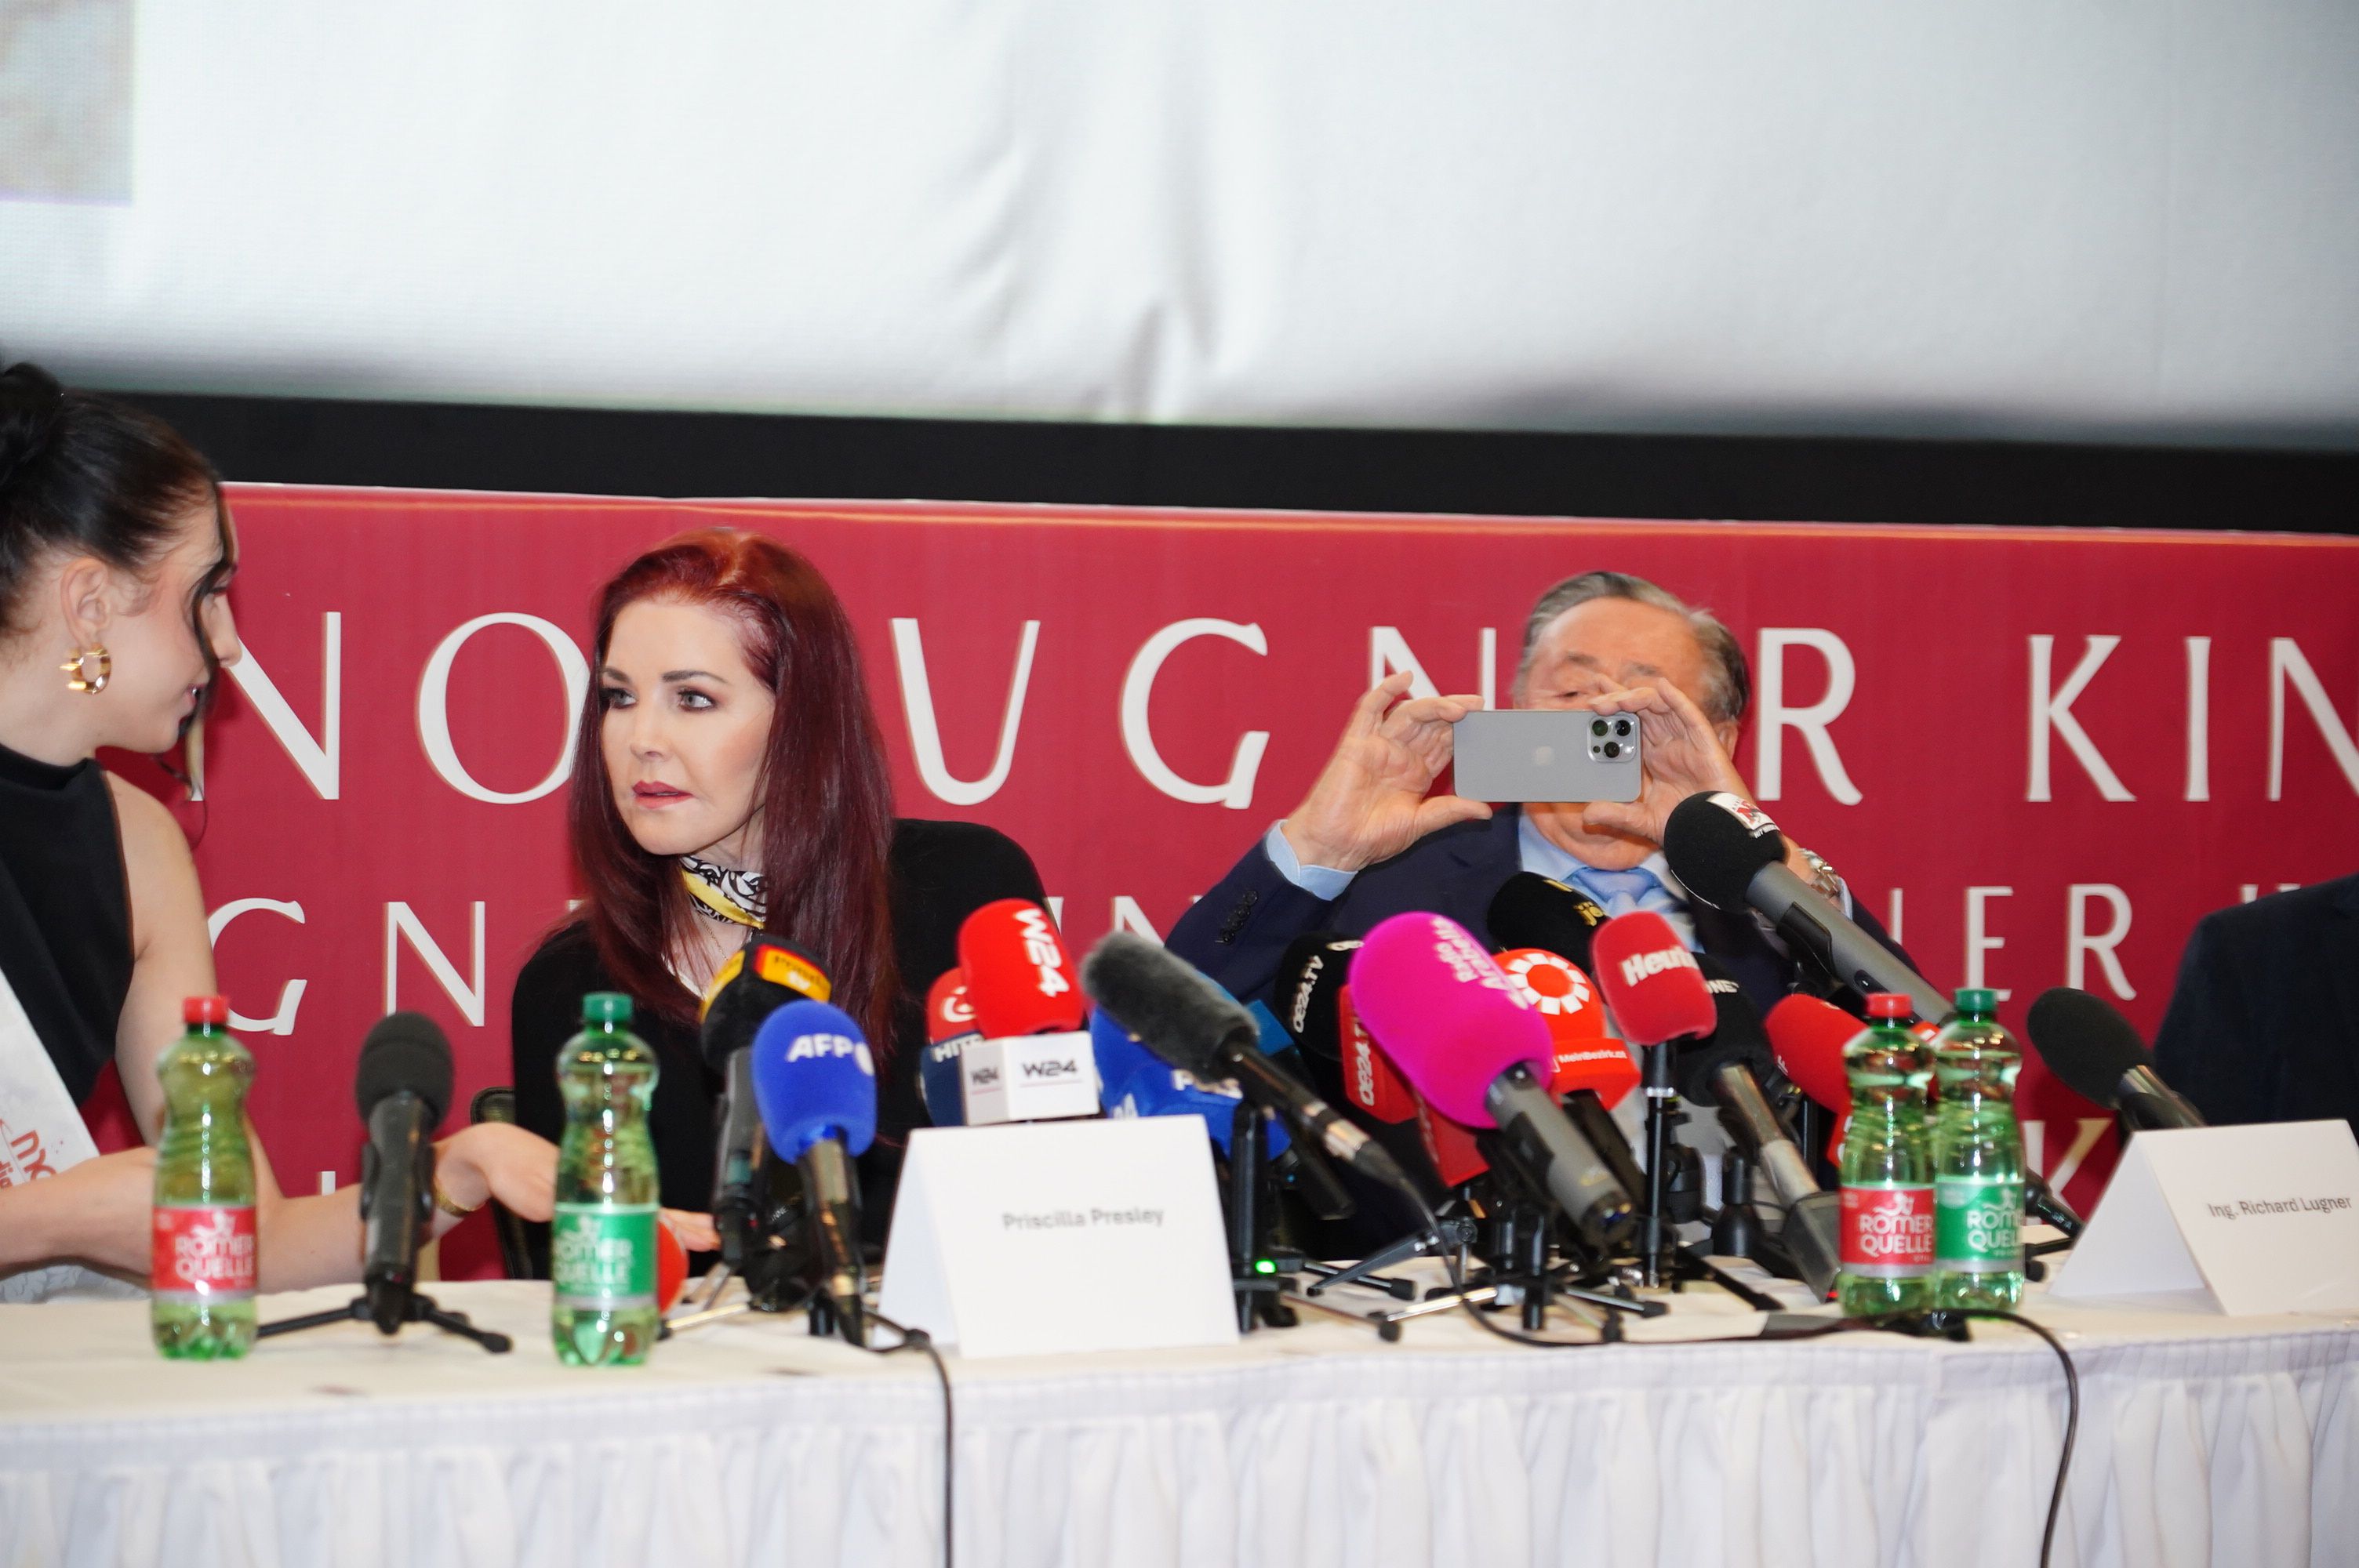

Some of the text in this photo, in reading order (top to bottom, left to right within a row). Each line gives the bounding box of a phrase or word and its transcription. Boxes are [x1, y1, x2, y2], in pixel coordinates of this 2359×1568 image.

[1014, 908, 1070, 997] W24
[787, 1033, 855, 1063] AFP
[1022, 1060, 1078, 1079] W24
[1002, 1207, 1165, 1231] Priscilla Presley
[2208, 1196, 2353, 1221] Ing. Richard Lugner
[1859, 1233, 1933, 1258] QUELLE
